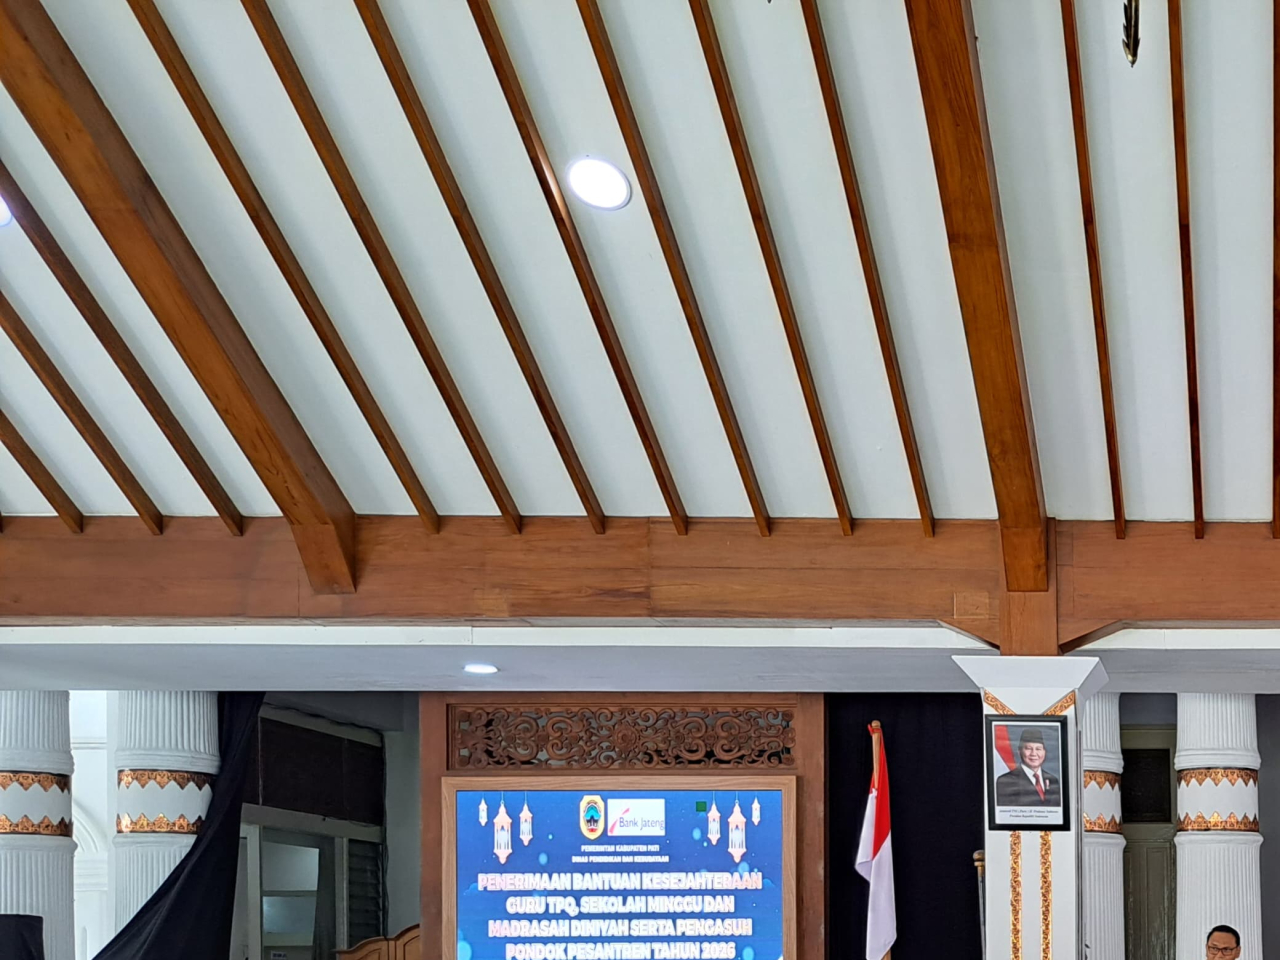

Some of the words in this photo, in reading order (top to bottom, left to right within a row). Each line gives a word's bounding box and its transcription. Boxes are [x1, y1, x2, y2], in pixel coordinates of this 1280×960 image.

[619, 817, 639, 828] Bank
[640, 817, 665, 831] Jateng
[478, 873, 571, 890] PENERIMAAN
[573, 873, 640, 890] BANTUAN
[642, 872, 763, 889] KESEJAHTERAAN
[506, 897, 546, 914] GURU
[547, 896, 579, 917] TPQ,
[580, 896, 646, 913] SEKOLAH
[647, 896, 702, 913] MINGGU
[703, 895, 735, 912] DAN
[488, 920, 570, 937] MADRASAH
[571, 920, 629, 936] DINIYAH
[629, 919, 676, 936] SERTA
[676, 918, 753, 936] PENGASUH
[505, 943, 567, 960] PONDOK
[567, 943, 651, 960] PESANTREN
[651, 942, 701, 959] TAHUN
[701, 942, 736, 959] 2026
